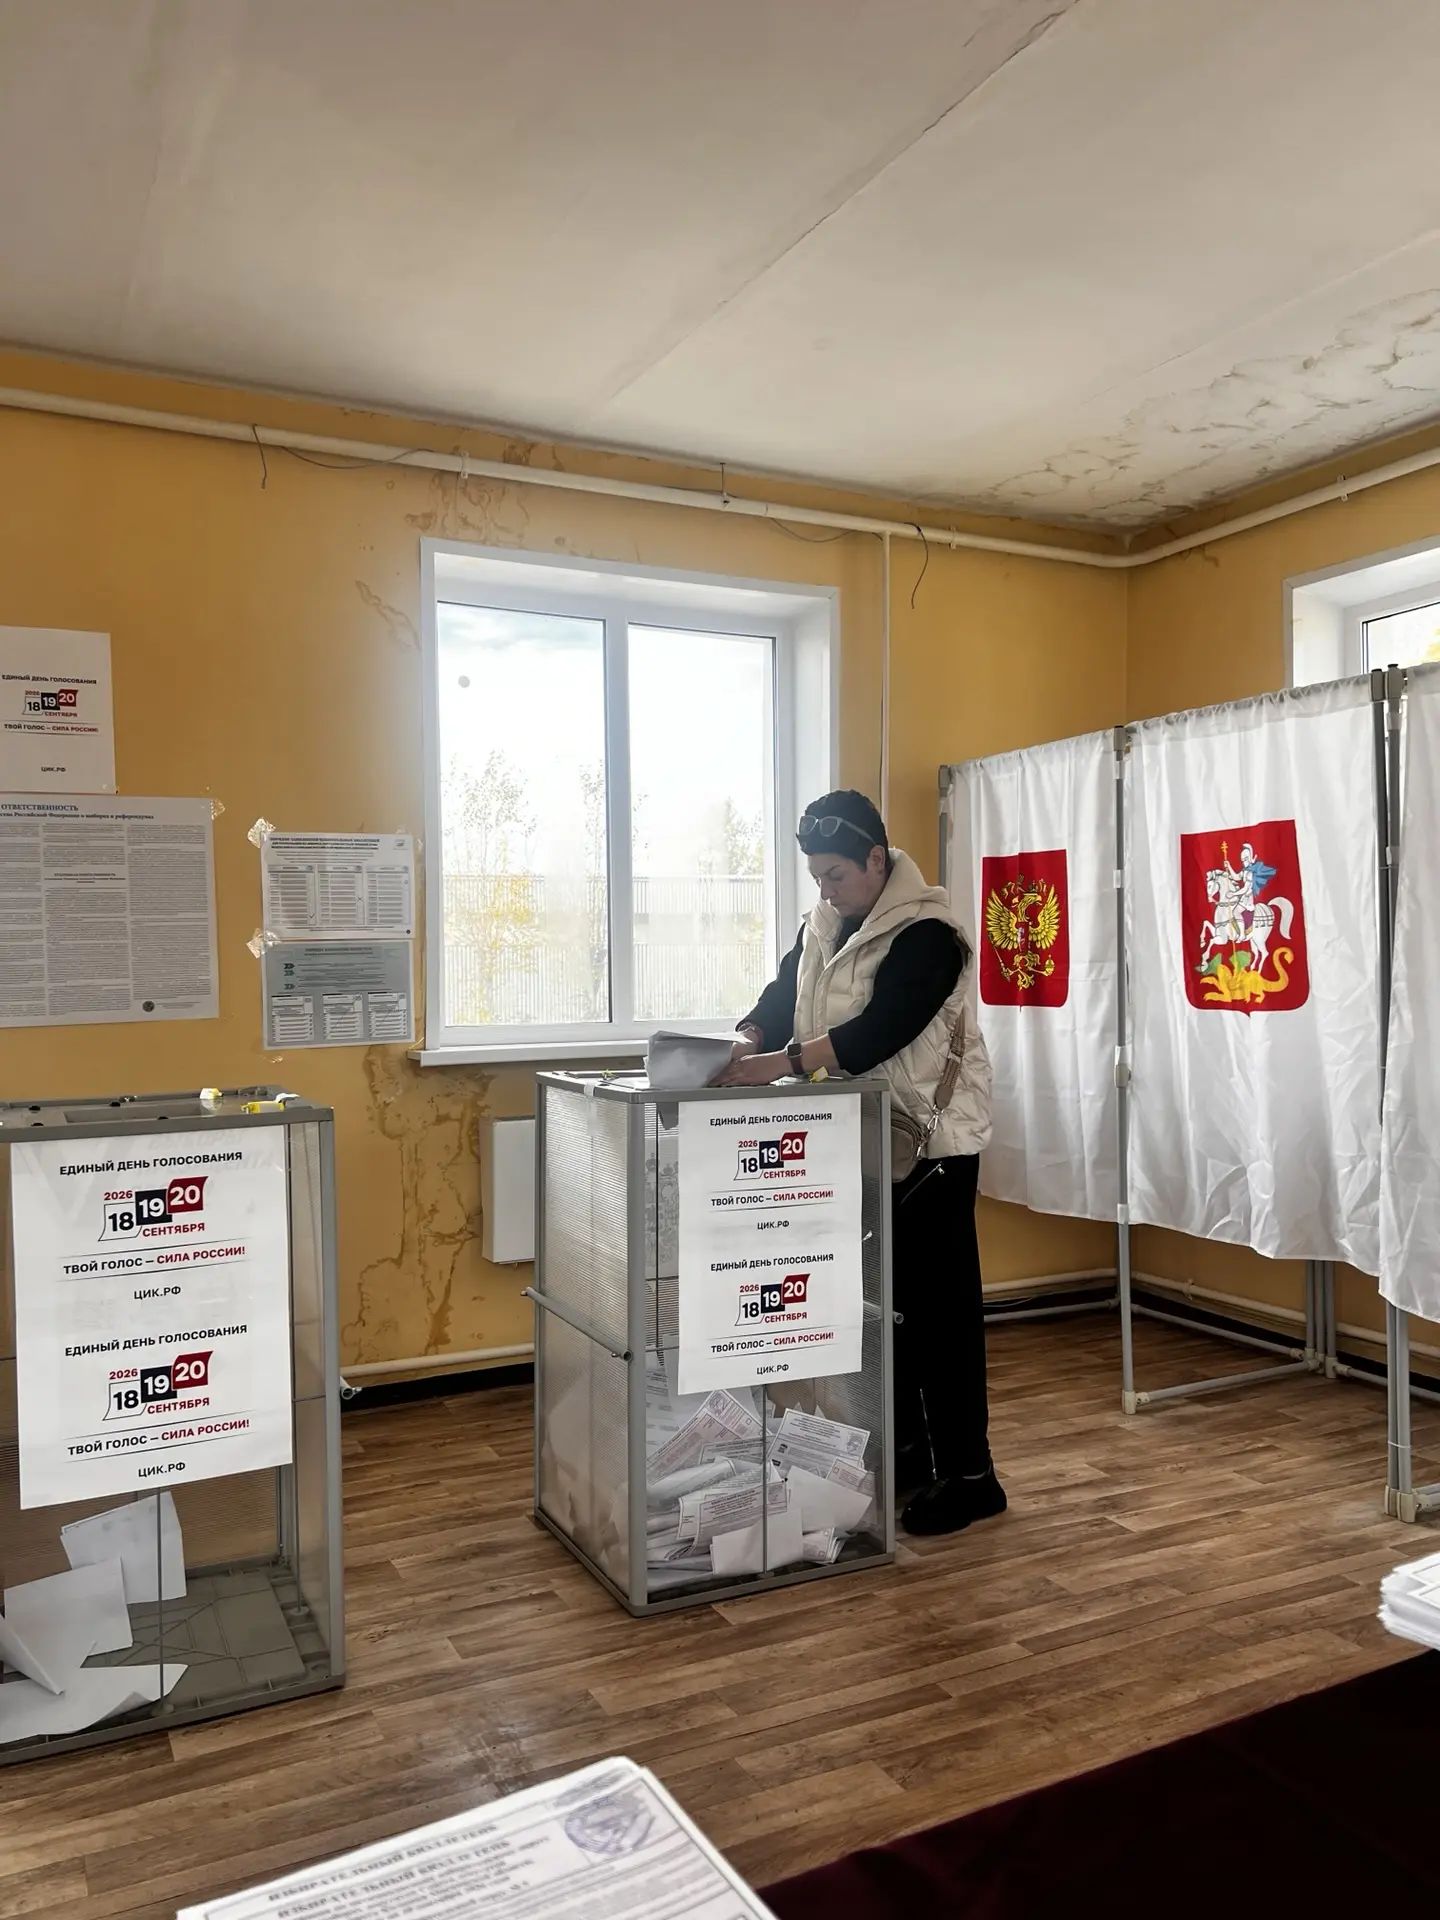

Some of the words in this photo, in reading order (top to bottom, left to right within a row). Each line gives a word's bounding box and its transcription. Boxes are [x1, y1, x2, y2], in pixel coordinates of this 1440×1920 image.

[50, 677, 97, 685] ГОЛОСОВАНИЯ
[27, 701, 40, 712] 18
[42, 696, 56, 707] 19
[59, 693, 75, 703] 20
[1, 803, 79, 812] ОТВЕТСТВЕННОСТЬ
[710, 1115, 747, 1127] ЕДИНЫЙ
[748, 1117, 770, 1126] ДЕНЬ
[772, 1112, 832, 1123] ГОЛОСОВАНИЯ
[738, 1140, 758, 1149] 2026
[59, 1160, 114, 1176] ЕДИНЫЙ
[117, 1160, 150, 1172] ДЕНЬ
[153, 1151, 243, 1168] ГОЛОСОВАНИЯ
[741, 1157, 758, 1173] 18
[762, 1147, 779, 1164] 19
[782, 1138, 803, 1155] 20
[763, 1169, 806, 1179] СЕНТЯБРЯ
[104, 1190, 133, 1201] 2026
[711, 1196, 734, 1207] ТВОЙ
[736, 1195, 764, 1205] ГОЛОС
[773, 1192, 796, 1202] СИЛА
[797, 1190, 834, 1200] РОССИИ!
[108, 1211, 134, 1232] 18
[139, 1197, 164, 1218] 19
[169, 1184, 200, 1206] 20
[142, 1222, 205, 1238] СЕНТЯБРЯ
[757, 1219, 790, 1231] ЦИК.РФ
[64, 1261, 98, 1275] ТВОЙ
[101, 1257, 143, 1271] ГОЛОС
[156, 1252, 190, 1264] СИЛА
[193, 1246, 246, 1260] РОССИИ!
[710, 1259, 747, 1272] ЕДИНЫЙ
[749, 1259, 772, 1270] ДЕНЬ
[773, 1253, 834, 1266] ГОЛОСОВАНИЯ
[133, 1285, 181, 1300] ЦИК.РФ
[739, 1284, 760, 1293] 2026
[742, 1302, 760, 1319] 18
[763, 1291, 780, 1308] 19
[784, 1280, 805, 1298] 20
[764, 1311, 807, 1324] СЕНТЯБРЯ
[65, 1340, 119, 1357] ЕДИНЫЙ
[122, 1336, 155, 1351] ДЕНЬ
[158, 1325, 247, 1345] ГОЛОСОВАНИЯ
[711, 1342, 734, 1353] ТВОЙ
[736, 1340, 764, 1350] ГОЛОС
[773, 1336, 796, 1346] СИЛА
[798, 1332, 834, 1343] РОССИИ!
[109, 1368, 138, 1380] 2026
[756, 1363, 789, 1375] ЦИК.РФ
[113, 1389, 139, 1411] 18
[144, 1374, 170, 1396] 19
[175, 1360, 206, 1382] 20
[147, 1397, 210, 1414] СЕНТЯБРЯ
[68, 1441, 102, 1456] ТВОЙ
[105, 1435, 147, 1450] ГОЛОС
[161, 1429, 195, 1442] СИЛА
[197, 1419, 250, 1436] РОССИИ!
[138, 1461, 186, 1478] ЦИК.РФ
